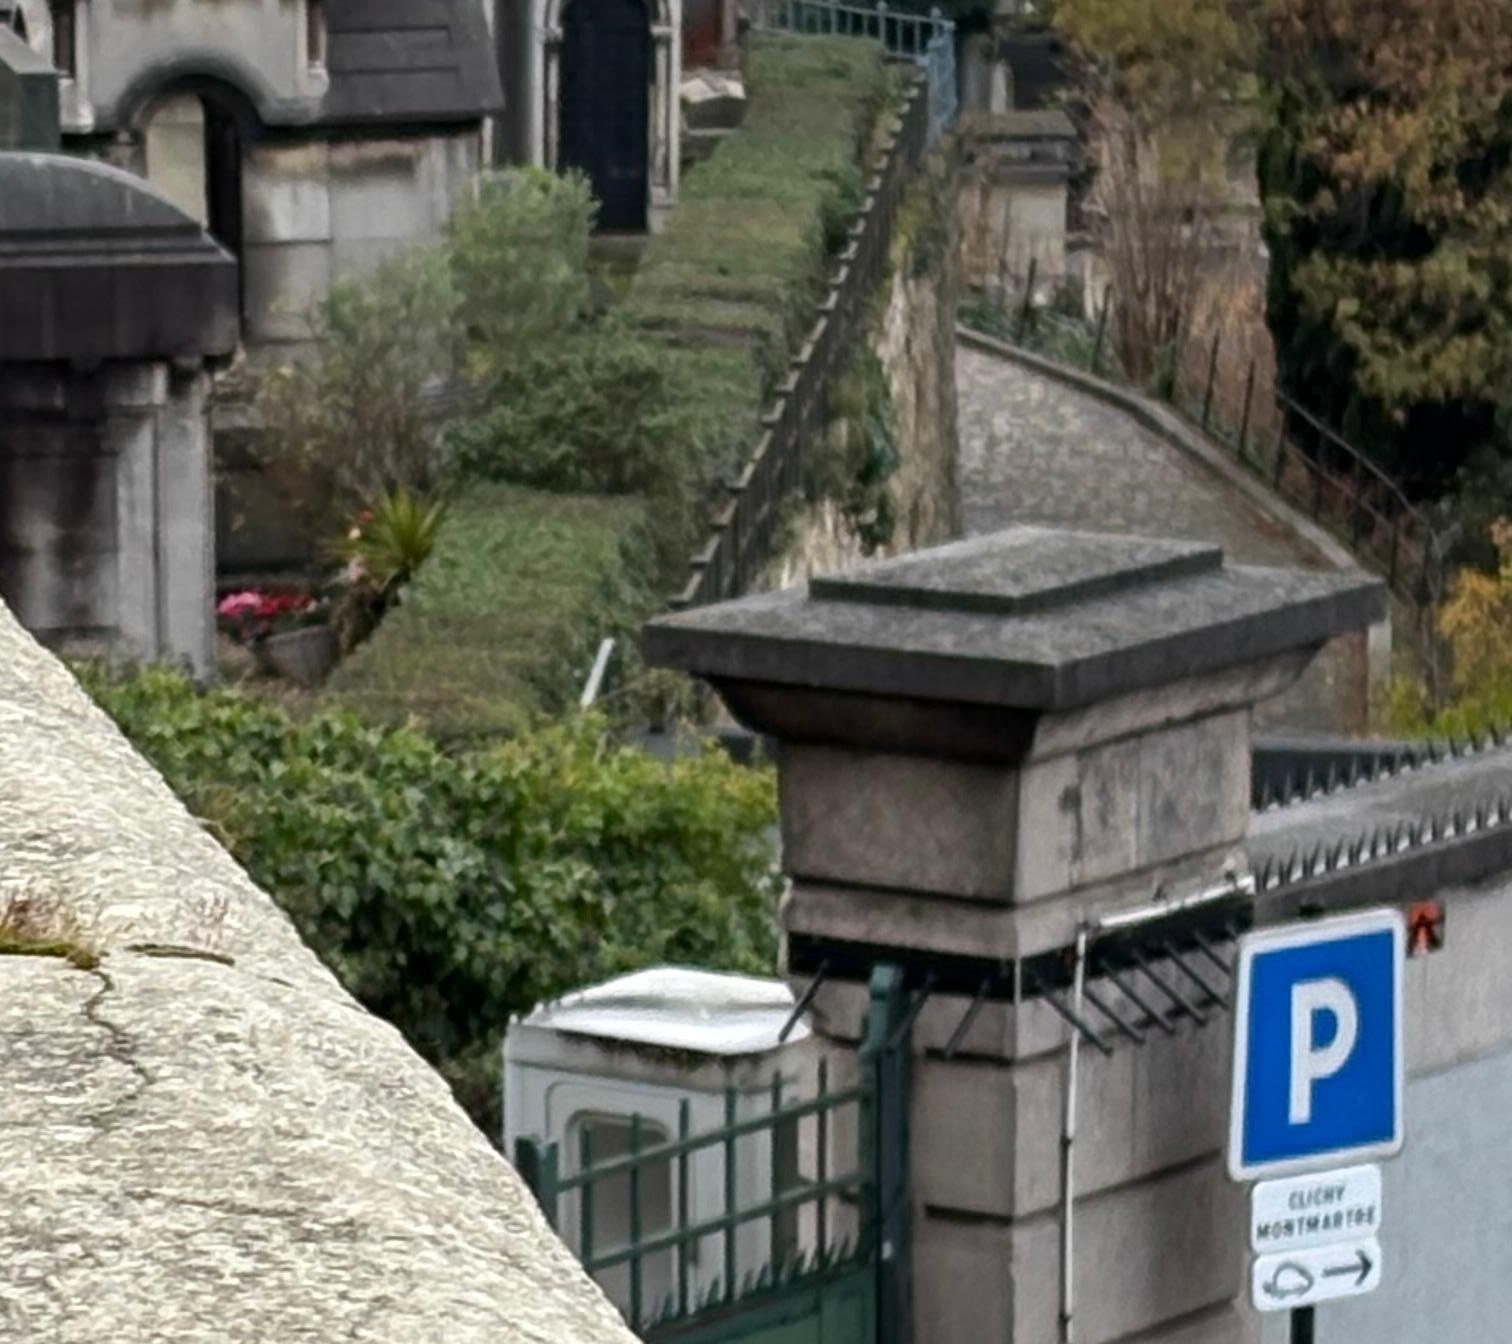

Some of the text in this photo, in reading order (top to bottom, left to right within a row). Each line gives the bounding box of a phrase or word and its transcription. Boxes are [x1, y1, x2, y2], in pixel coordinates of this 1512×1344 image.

[1288, 976, 1358, 1125] P
[1288, 1186, 1346, 1210] CLICHY
[1256, 1206, 1375, 1240] MONTMARTRE
